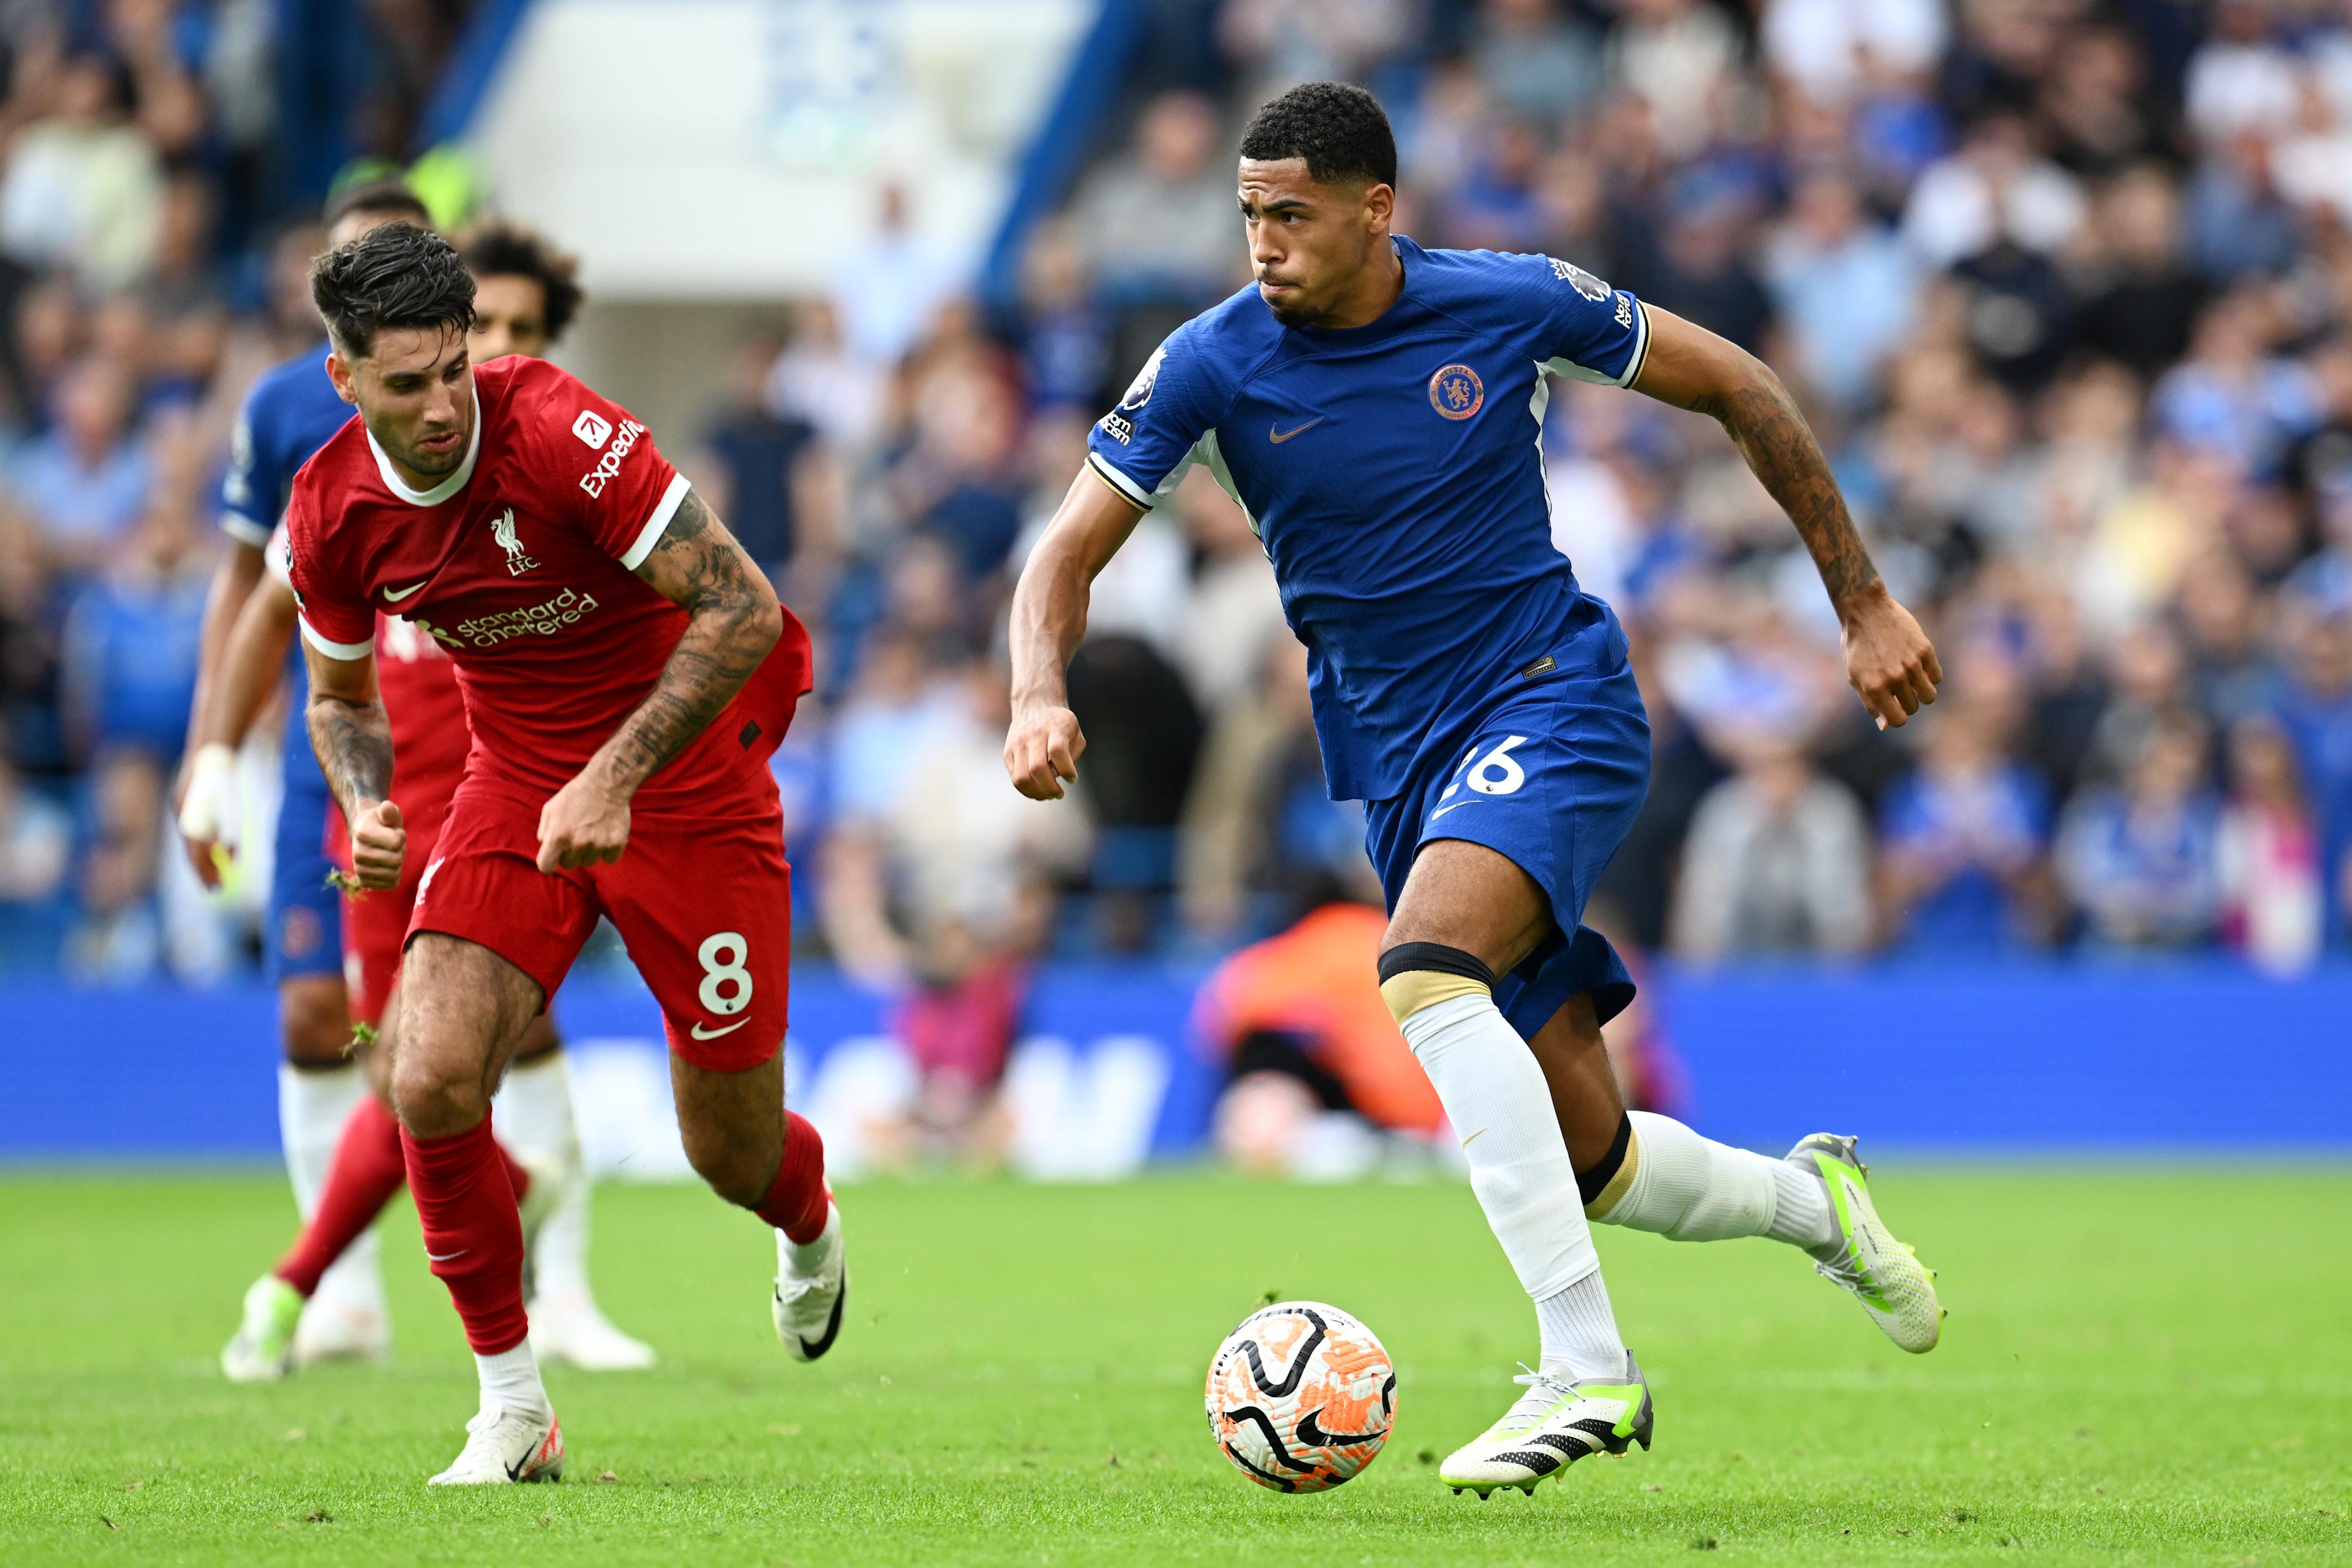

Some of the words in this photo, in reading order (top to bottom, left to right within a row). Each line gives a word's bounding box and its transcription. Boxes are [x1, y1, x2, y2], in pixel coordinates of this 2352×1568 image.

[1435, 368, 1469, 383] CHELSEA
[507, 557, 541, 577] L.F.C.
[457, 587, 578, 638] standard
[473, 593, 599, 647] chartered
[698, 931, 753, 1016] 8
